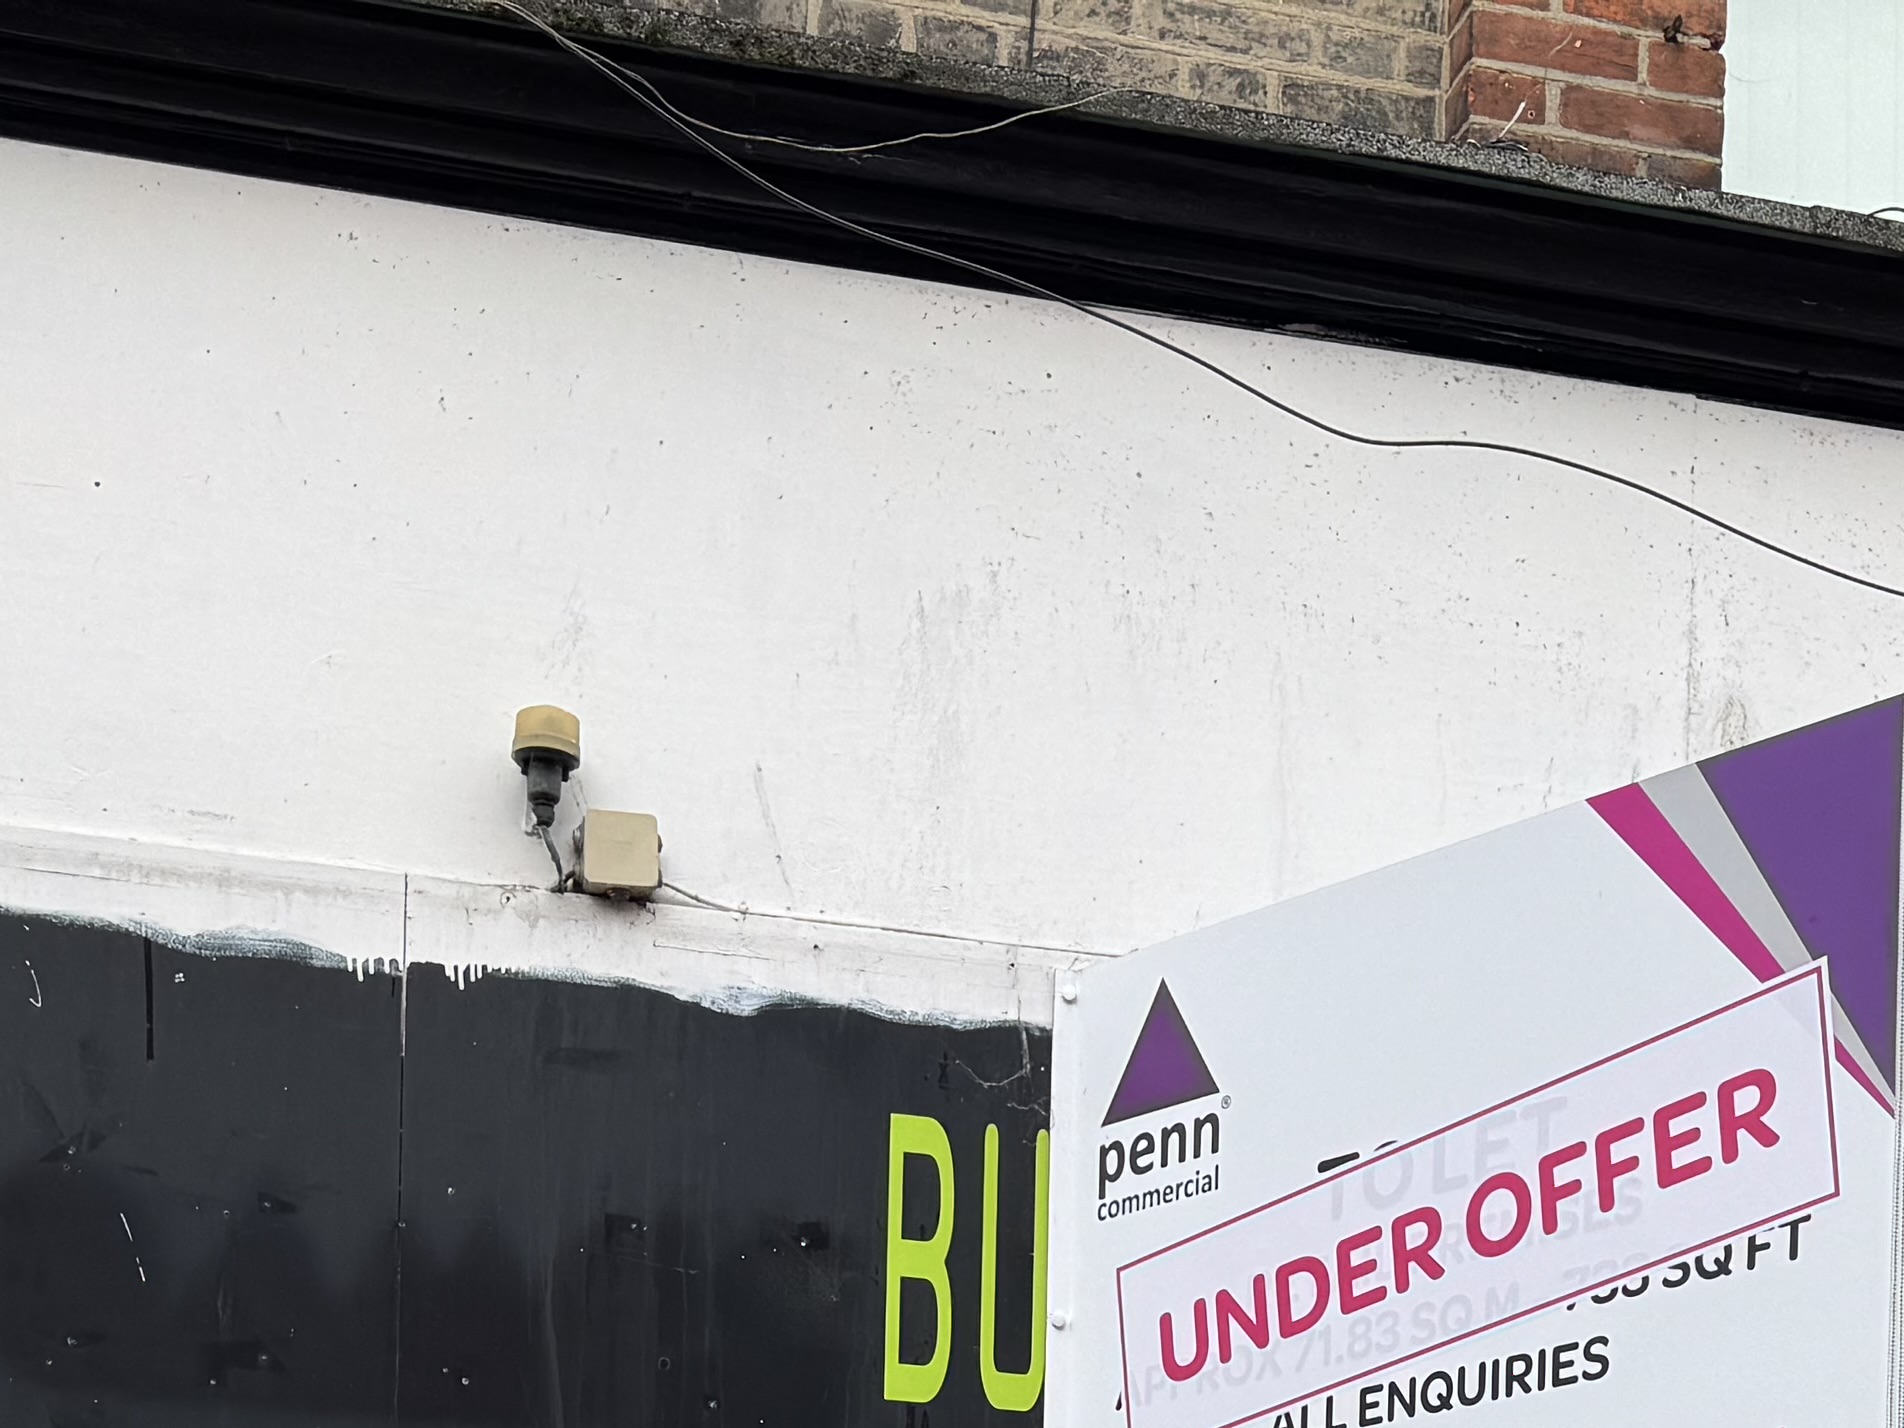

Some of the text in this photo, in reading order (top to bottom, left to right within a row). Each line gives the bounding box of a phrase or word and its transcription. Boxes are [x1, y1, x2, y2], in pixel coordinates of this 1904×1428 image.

[1098, 1164, 1219, 1221] commercial
[1099, 1113, 1219, 1200] penn
[884, 1113, 1049, 1411] BU
[1160, 1207, 1445, 1382] UNDER
[1466, 1069, 1780, 1257] OFFER
[1359, 1336, 1609, 1427] ENQUIRIES
